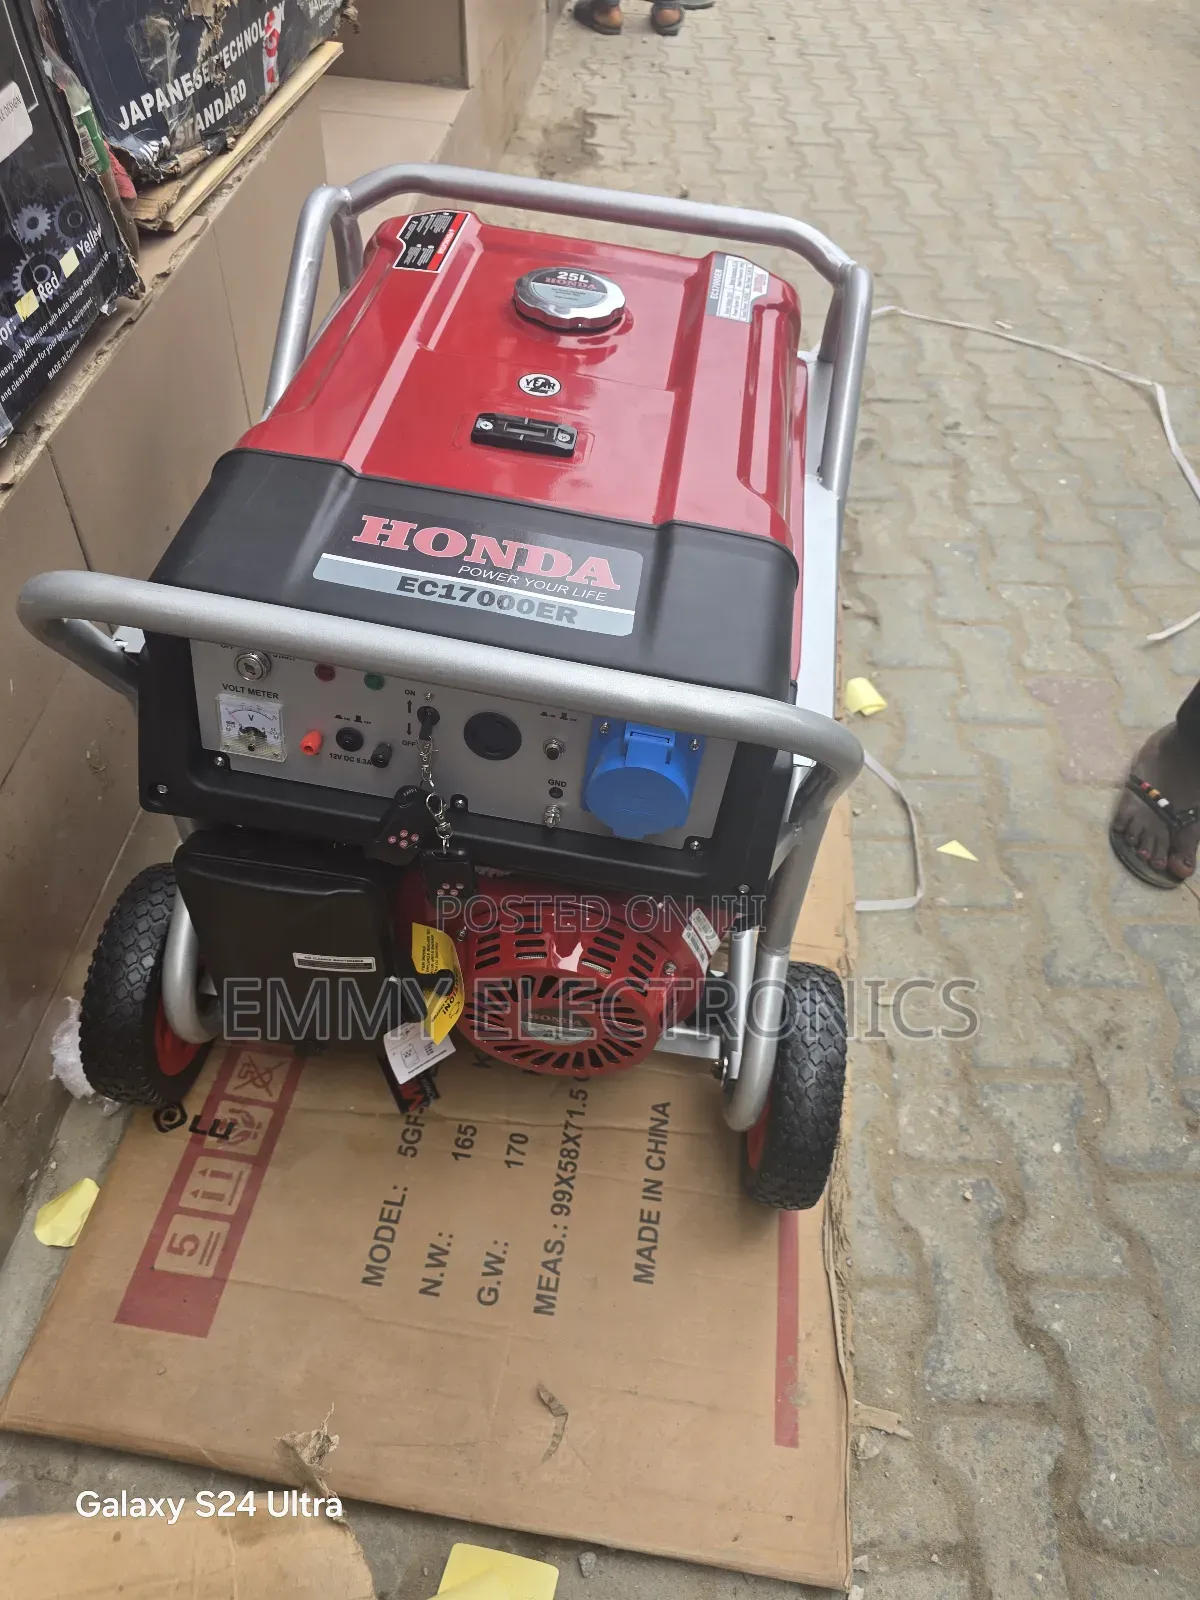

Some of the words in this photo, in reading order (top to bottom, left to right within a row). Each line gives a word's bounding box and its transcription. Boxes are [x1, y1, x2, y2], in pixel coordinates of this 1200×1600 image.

[119, 61, 213, 131] JAPANESE
[175, 78, 247, 146] STANDARD
[37, 271, 60, 303] Red
[544, 277, 598, 290] HONDA
[556, 271, 589, 283] 25L
[24, 322, 49, 351] Alternator
[48, 312, 59, 327] with
[57, 302, 70, 319] Auto
[0, 387, 12, 402] and
[11, 373, 25, 391] clean
[24, 358, 39, 379] power
[38, 350, 47, 361] for
[46, 339, 57, 355] your
[56, 326, 69, 341] tools
[47, 361, 63, 380] MADE
[61, 354, 68, 365] IN
[66, 339, 80, 358] CHINA
[351, 514, 621, 590] HONDA
[396, 575, 579, 625] EC17000ER
[458, 565, 520, 585] POWER
[524, 577, 570, 596] YOUR
[572, 587, 608, 602] LIFE
[221, 683, 245, 694] VOLT
[247, 687, 280, 700] METER
[404, 689, 416, 697] ON
[248, 713, 254, 721] V
[329, 752, 342, 761] 12V
[343, 755, 355, 763] DC
[401, 739, 416, 747] OFF
[547, 778, 567, 788] GND
[550, 1088, 589, 1217] 99X58X71.5
[645, 1101, 671, 1172] CHINA
[418, 1232, 453, 1297] N.W.:
[451, 1123, 478, 1161] 165
[642, 1178, 663, 1202] IN
[360, 1184, 408, 1287] MODEL:
[476, 1239, 509, 1306] G.W.:
[504, 1132, 529, 1169] 170
[533, 1223, 568, 1316] MEAS.:
[633, 1208, 661, 1285] MADE
